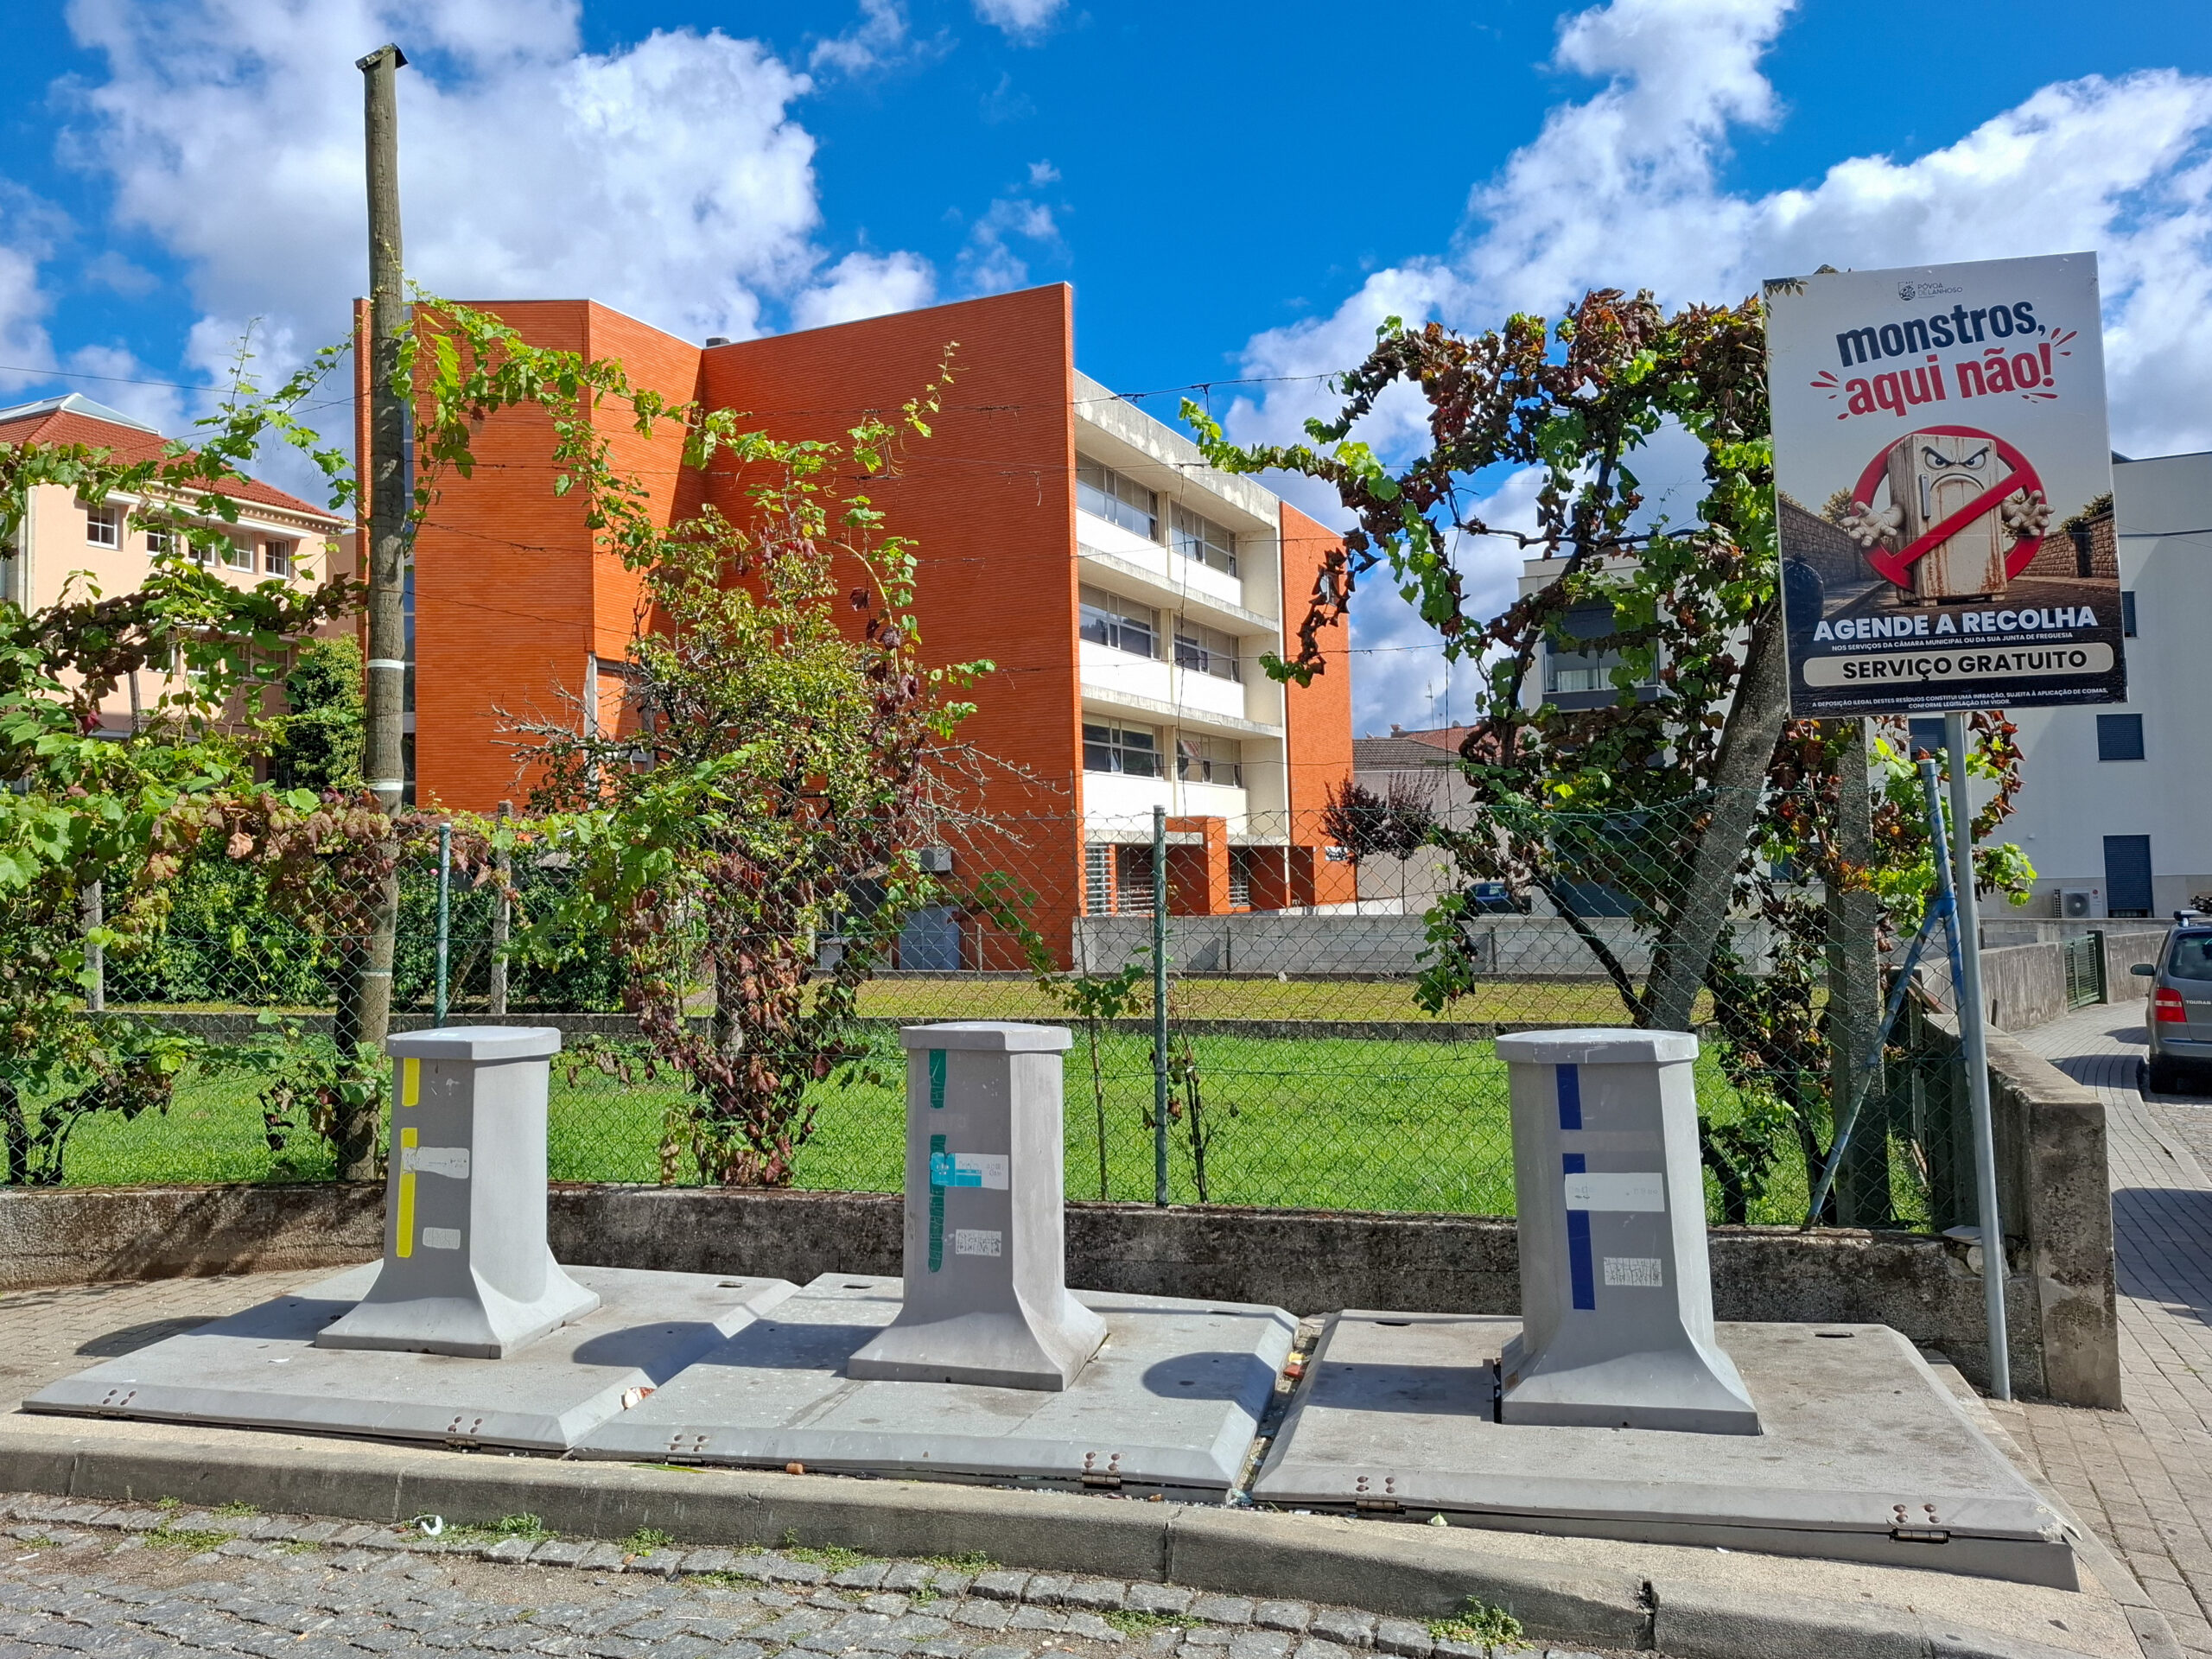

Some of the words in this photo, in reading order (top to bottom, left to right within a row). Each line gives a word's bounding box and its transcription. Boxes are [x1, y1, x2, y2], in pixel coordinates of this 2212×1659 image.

[1836, 300, 2047, 367] monstros,
[1845, 354, 1947, 417] aqui
[1956, 342, 2056, 398] não!
[1814, 615, 1929, 641] AGENDE
[1936, 613, 1957, 634] A
[1962, 606, 2099, 633] RECOLHA
[1847, 643, 1882, 651] SERVIÇOS
[1843, 657, 1952, 682] SERVIÇO
[1958, 650, 2088, 673] GRATUITO
[1818, 699, 1853, 708] DEPOSIÇÃO
[1943, 699, 1980, 708] LEGISLAÇÃO
